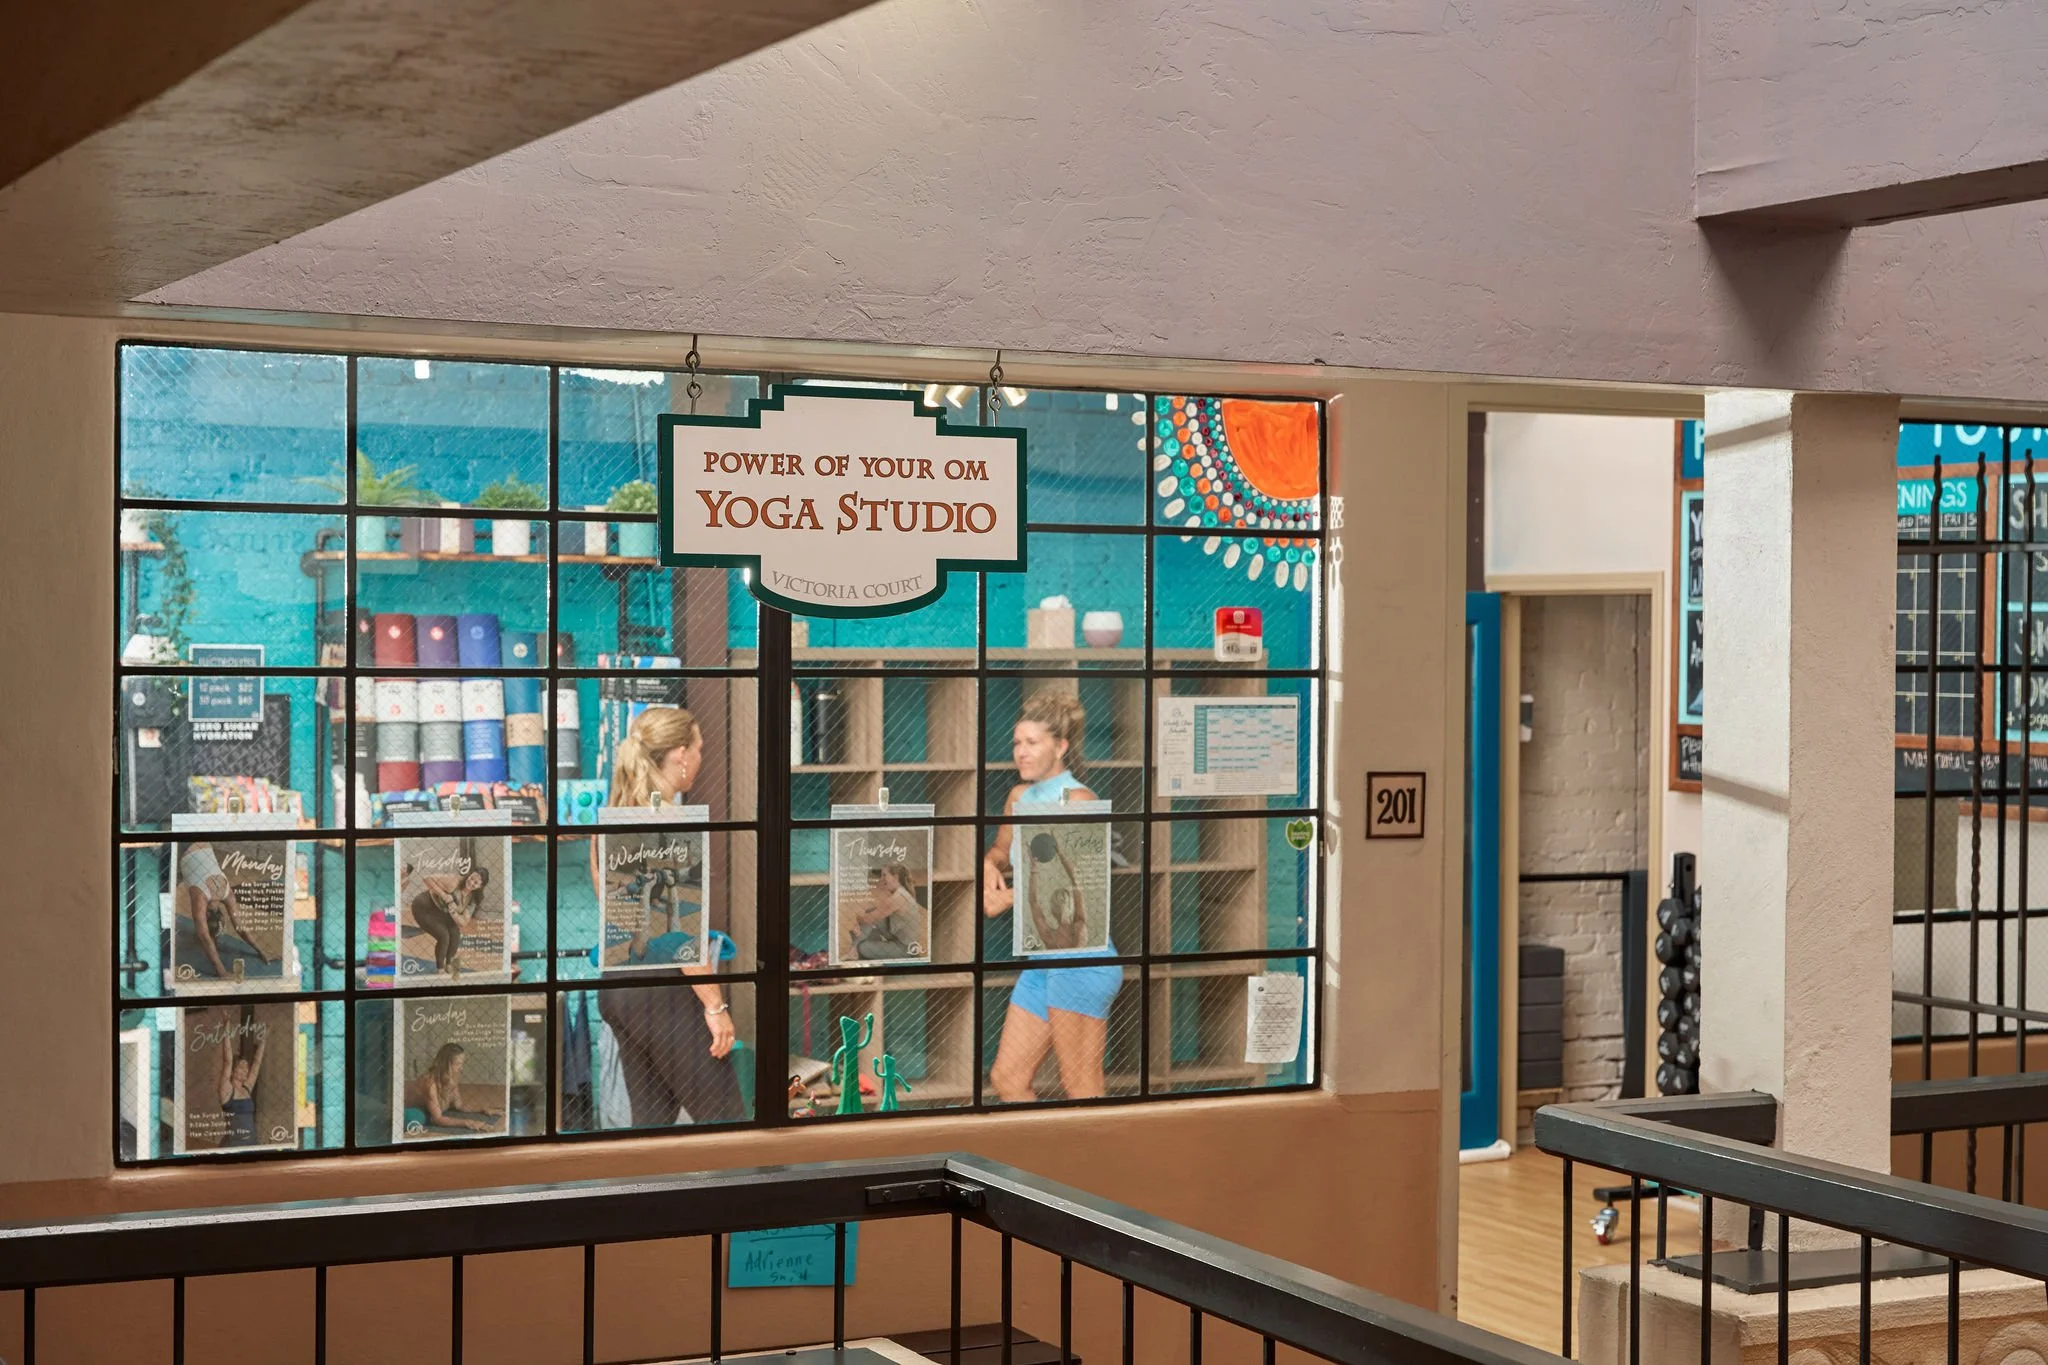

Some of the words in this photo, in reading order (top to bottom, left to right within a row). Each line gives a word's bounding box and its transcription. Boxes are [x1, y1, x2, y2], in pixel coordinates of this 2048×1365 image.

[703, 452, 805, 477] POWER
[814, 454, 850, 477] OF
[858, 456, 936, 480] YOUR
[944, 459, 989, 481] OM
[1898, 481, 1968, 509] NINGS
[695, 490, 824, 531] YOGA
[836, 491, 997, 535] STUDIO
[771, 570, 859, 600] VICTORIA
[863, 574, 923, 599] COURT
[193, 722, 222, 732] ZERO
[223, 722, 259, 732] SUGAR
[193, 731, 254, 741] HYDRATION
[1376, 787, 1416, 825] 201
[608, 839, 689, 871] Wednesday
[846, 837, 907, 862] Thursday
[1064, 829, 1104, 855] Friday
[221, 850, 284, 880] Monday
[411, 848, 472, 875] Tuesday
[411, 1002, 467, 1032] Sunday
[190, 1015, 267, 1052] Saturday
[745, 1249, 814, 1273] Adrienne
